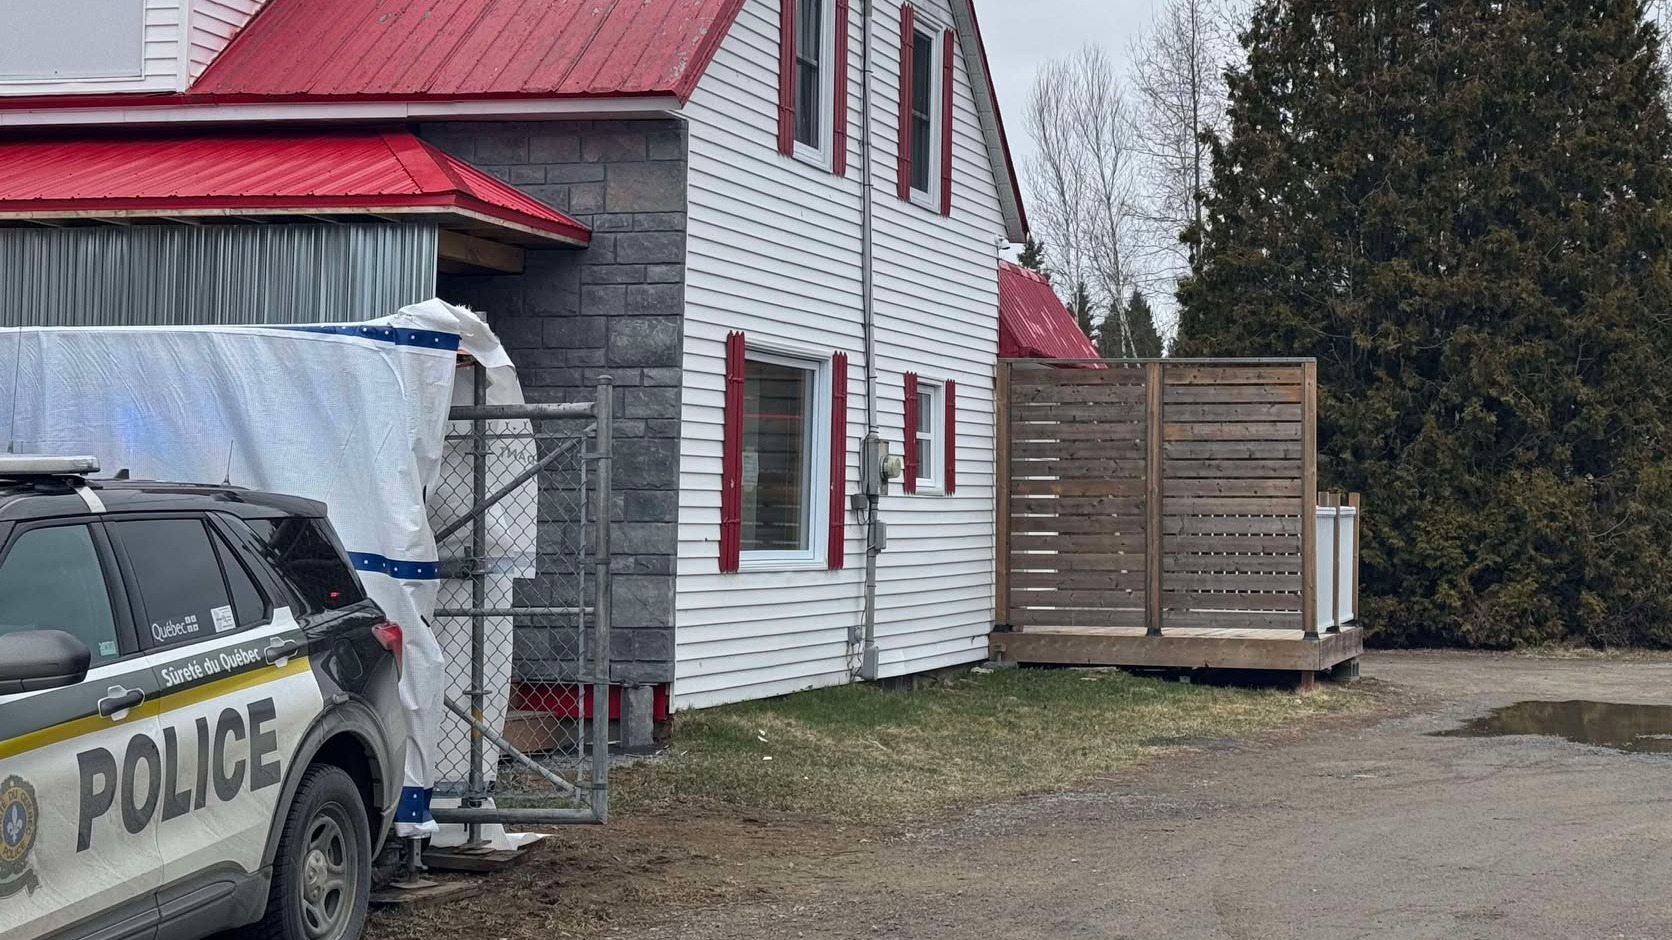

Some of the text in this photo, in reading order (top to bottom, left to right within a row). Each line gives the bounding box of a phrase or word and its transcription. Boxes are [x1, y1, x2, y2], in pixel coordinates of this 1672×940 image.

[151, 620, 188, 642] Québec
[161, 648, 261, 687] Sûreté du Québec
[76, 697, 281, 853] POLICE
